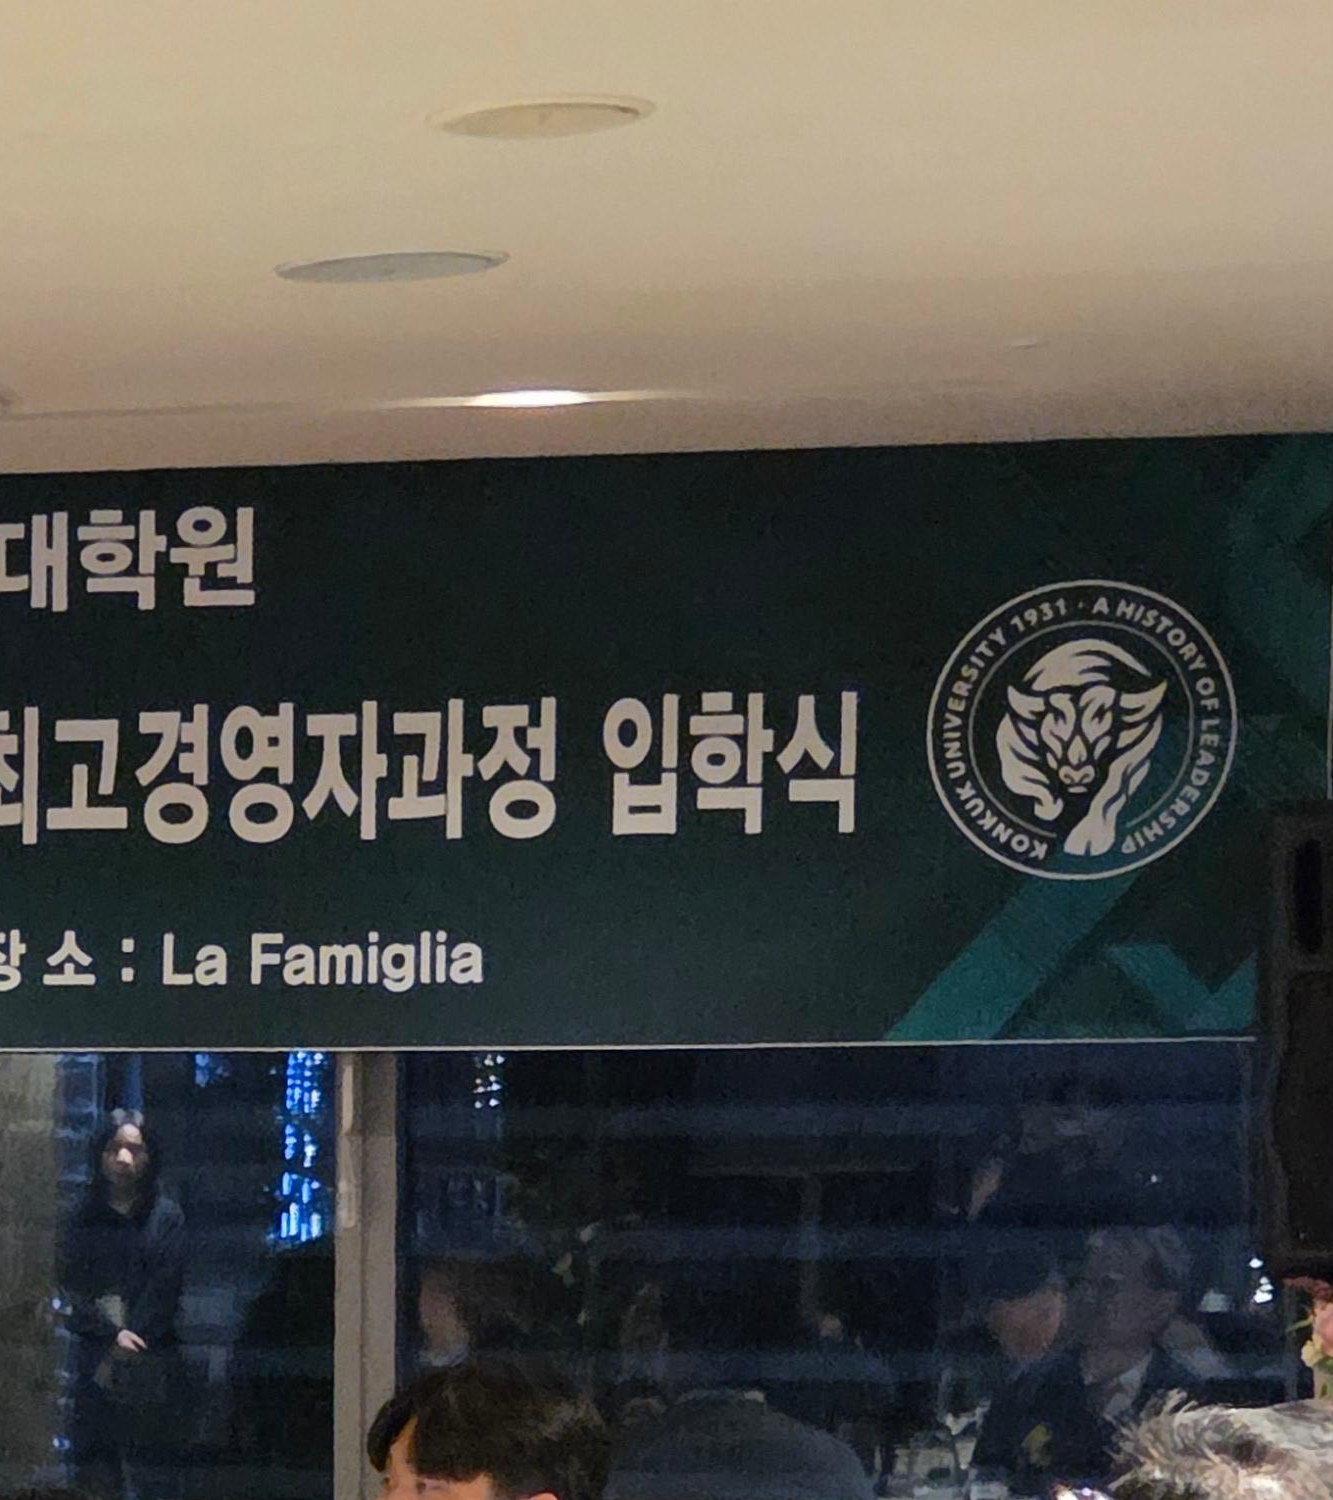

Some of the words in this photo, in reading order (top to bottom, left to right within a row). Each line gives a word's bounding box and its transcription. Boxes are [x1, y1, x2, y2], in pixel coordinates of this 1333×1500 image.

[1011, 598, 1068, 632] 1931
[1091, 596, 1110, 615] A
[1116, 598, 1207, 672] HISTORY
[942, 627, 1008, 777] UNIVERSITY
[1195, 676, 1221, 714] OF
[602, 689, 859, 837] 입학식
[1120, 718, 1221, 854] LEADERSHIP
[954, 779, 1049, 861] KONKUK
[161, 931, 229, 987] La
[249, 929, 485, 994] Famiglia
